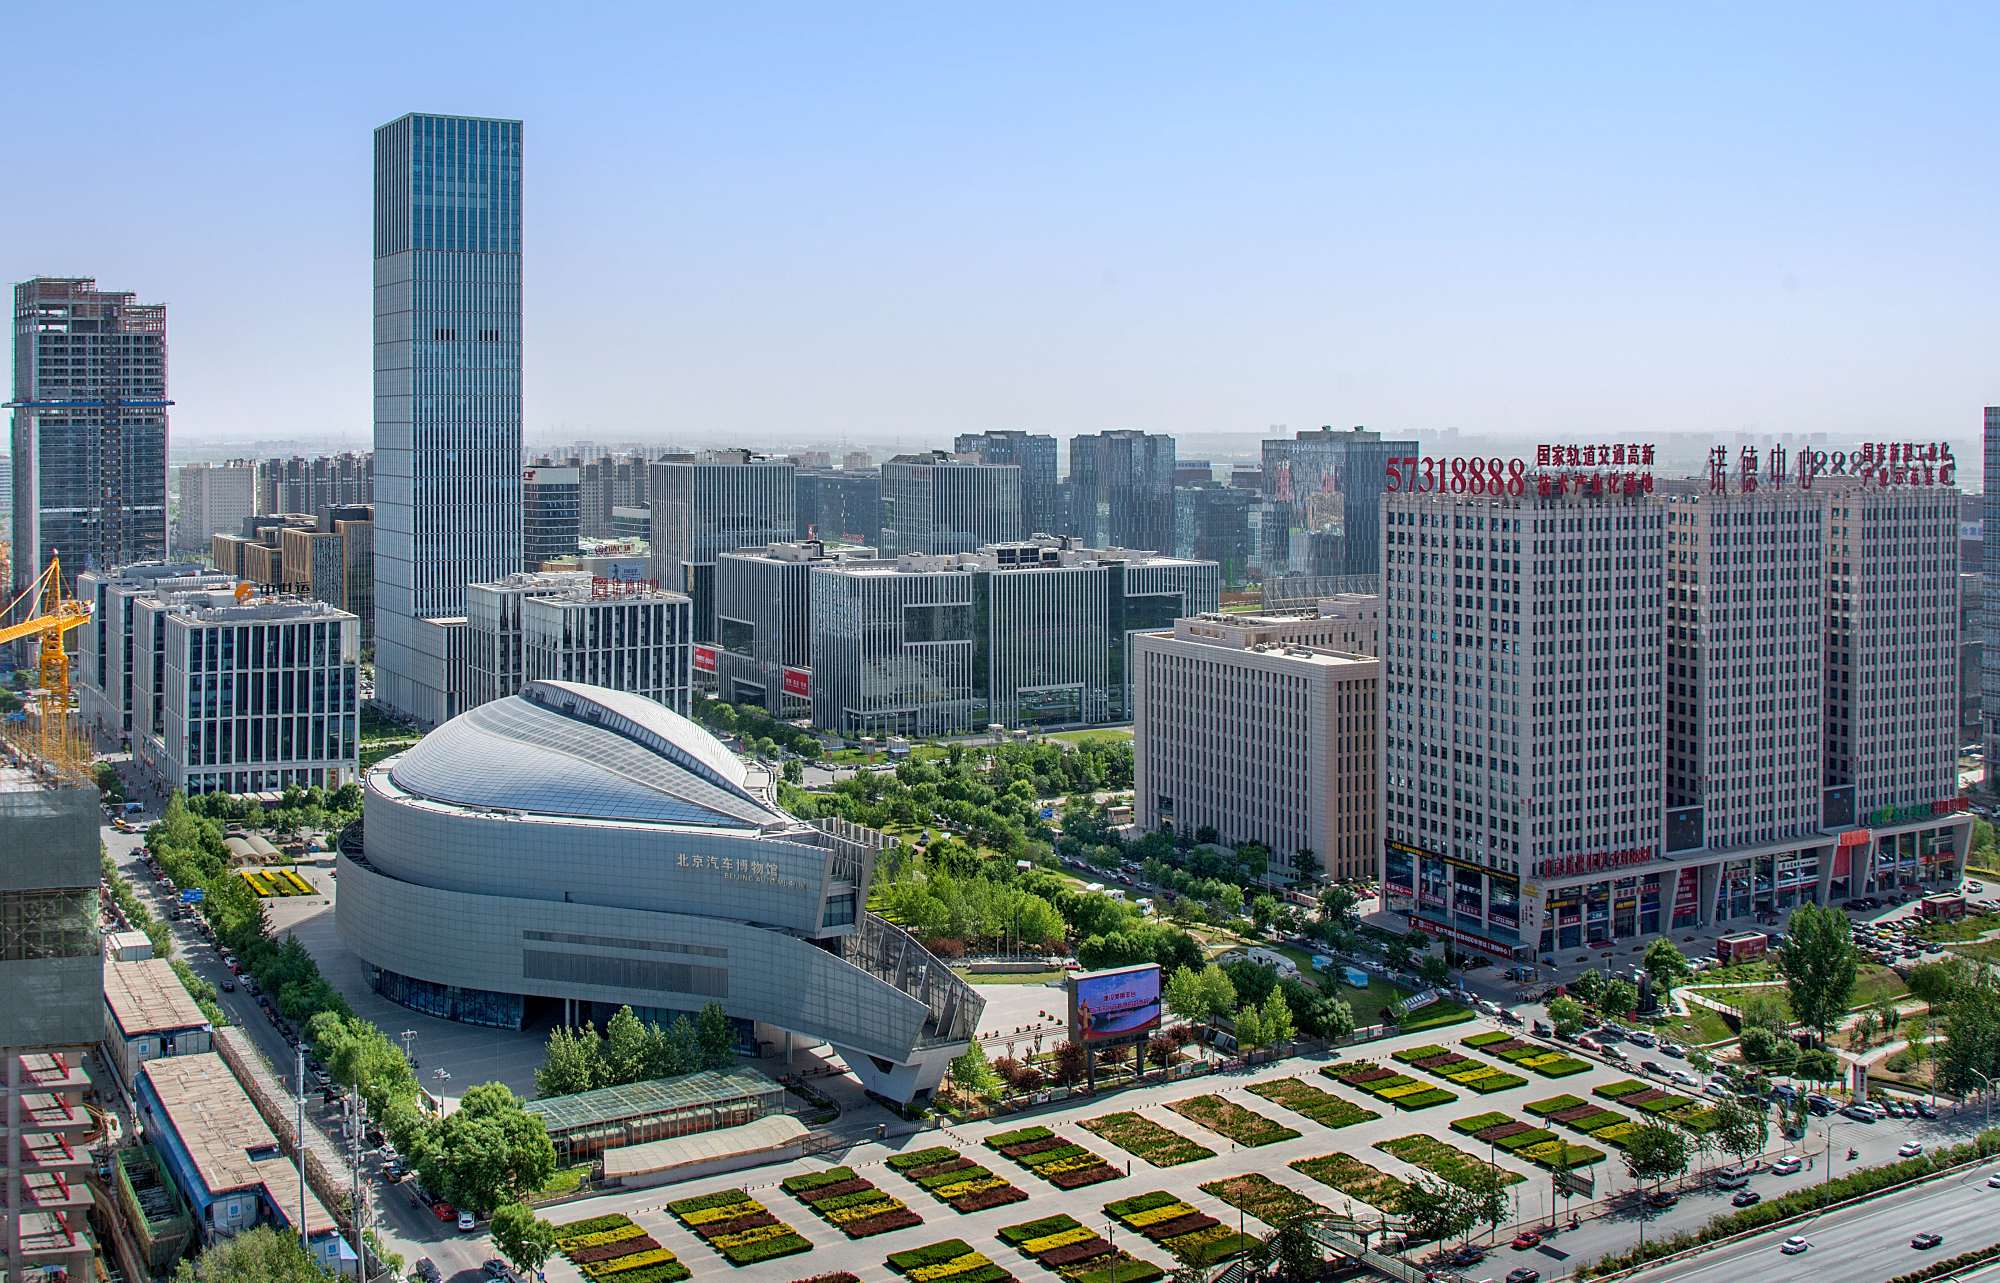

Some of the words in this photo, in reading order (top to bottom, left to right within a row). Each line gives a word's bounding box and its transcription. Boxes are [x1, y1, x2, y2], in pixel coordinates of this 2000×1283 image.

[1537, 443, 1656, 467] 国家轨道交通高新
[1709, 443, 1814, 492] 诺德中心
[1386, 456, 1525, 496] 57318888
[1537, 471, 1654, 497] 技术产业化基地
[677, 853, 778, 878] 北京汽车博物馆
[724, 872, 753, 883] BEIJING
